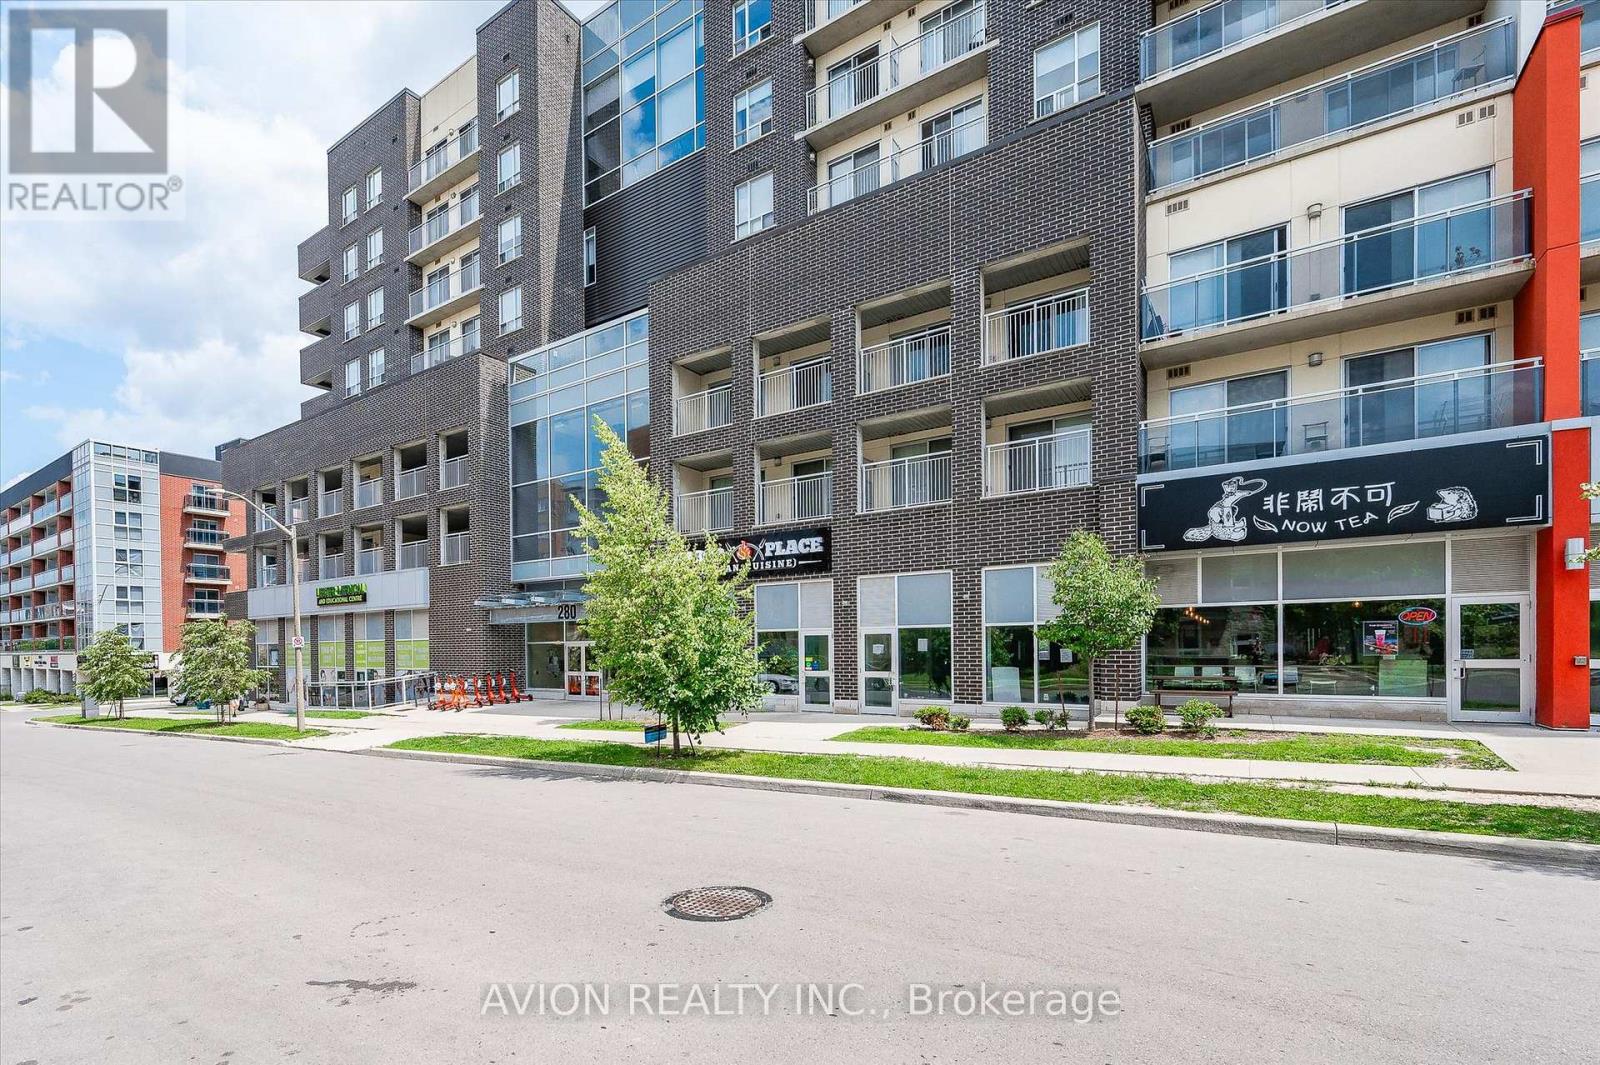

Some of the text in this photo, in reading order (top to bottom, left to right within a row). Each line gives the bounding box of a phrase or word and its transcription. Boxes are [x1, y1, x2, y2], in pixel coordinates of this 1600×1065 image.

[1263, 482, 1396, 516] 非鬧不可
[1281, 511, 1379, 533] NOW TEA
[765, 537, 824, 557] PLACE
[751, 558, 797, 570] UISINE)
[557, 604, 577, 619] 280
[1401, 611, 1434, 621] OPEN
